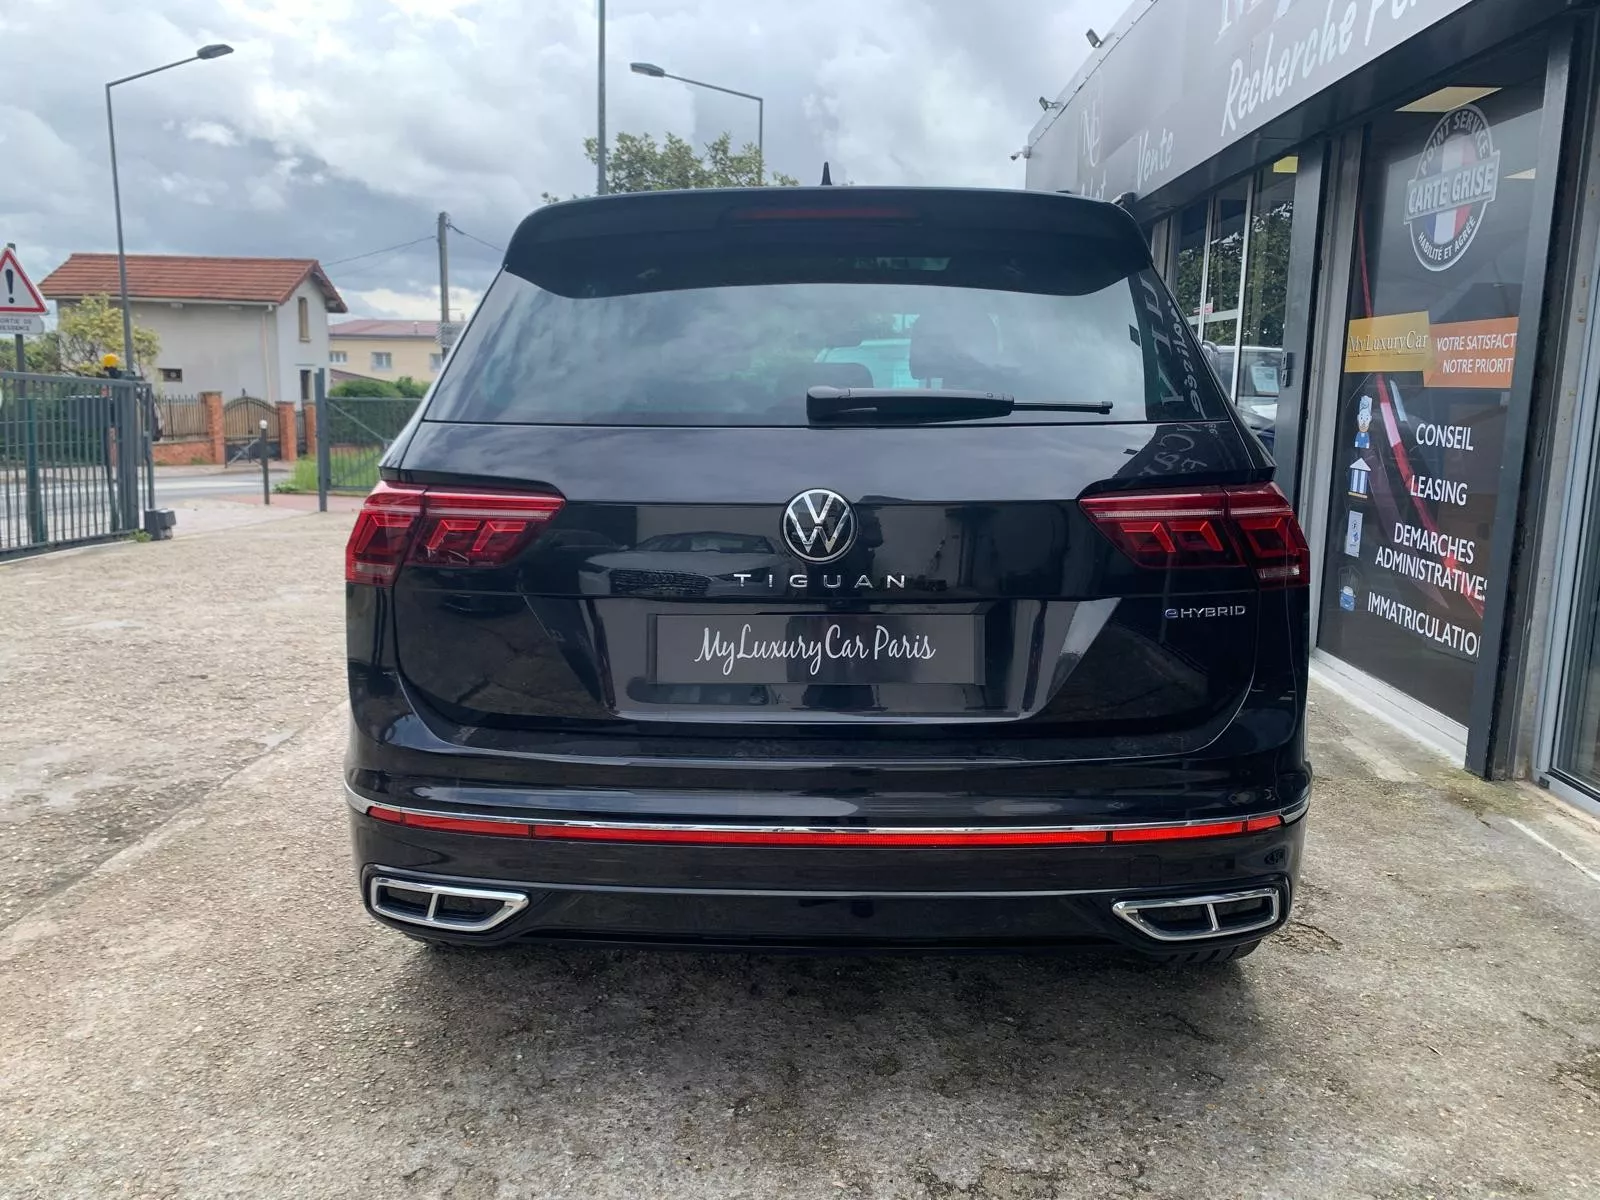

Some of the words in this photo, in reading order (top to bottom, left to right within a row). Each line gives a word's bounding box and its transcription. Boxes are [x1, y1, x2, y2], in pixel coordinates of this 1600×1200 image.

[1221, 0, 1357, 136] Recherche
[1137, 128, 1173, 190] Vente
[1420, 118, 1450, 176] POINT
[1453, 110, 1489, 158] SERVICE
[1408, 179, 1448, 214] CARTE
[1452, 163, 1494, 202] GRISE
[1443, 245, 1453, 259] ET
[1437, 335, 1465, 352] VOTRE
[1466, 332, 1517, 350] SATISFACT
[1442, 359, 1473, 373] NOTRE
[1416, 423, 1474, 451] CONSEIL
[1410, 475, 1468, 506] LEASING
[1394, 522, 1475, 564] DEMARCHES
[733, 573, 905, 588] TIGUAN
[874, 624, 937, 660] Paris
[1368, 591, 1481, 658] IMMATRICULATIO
